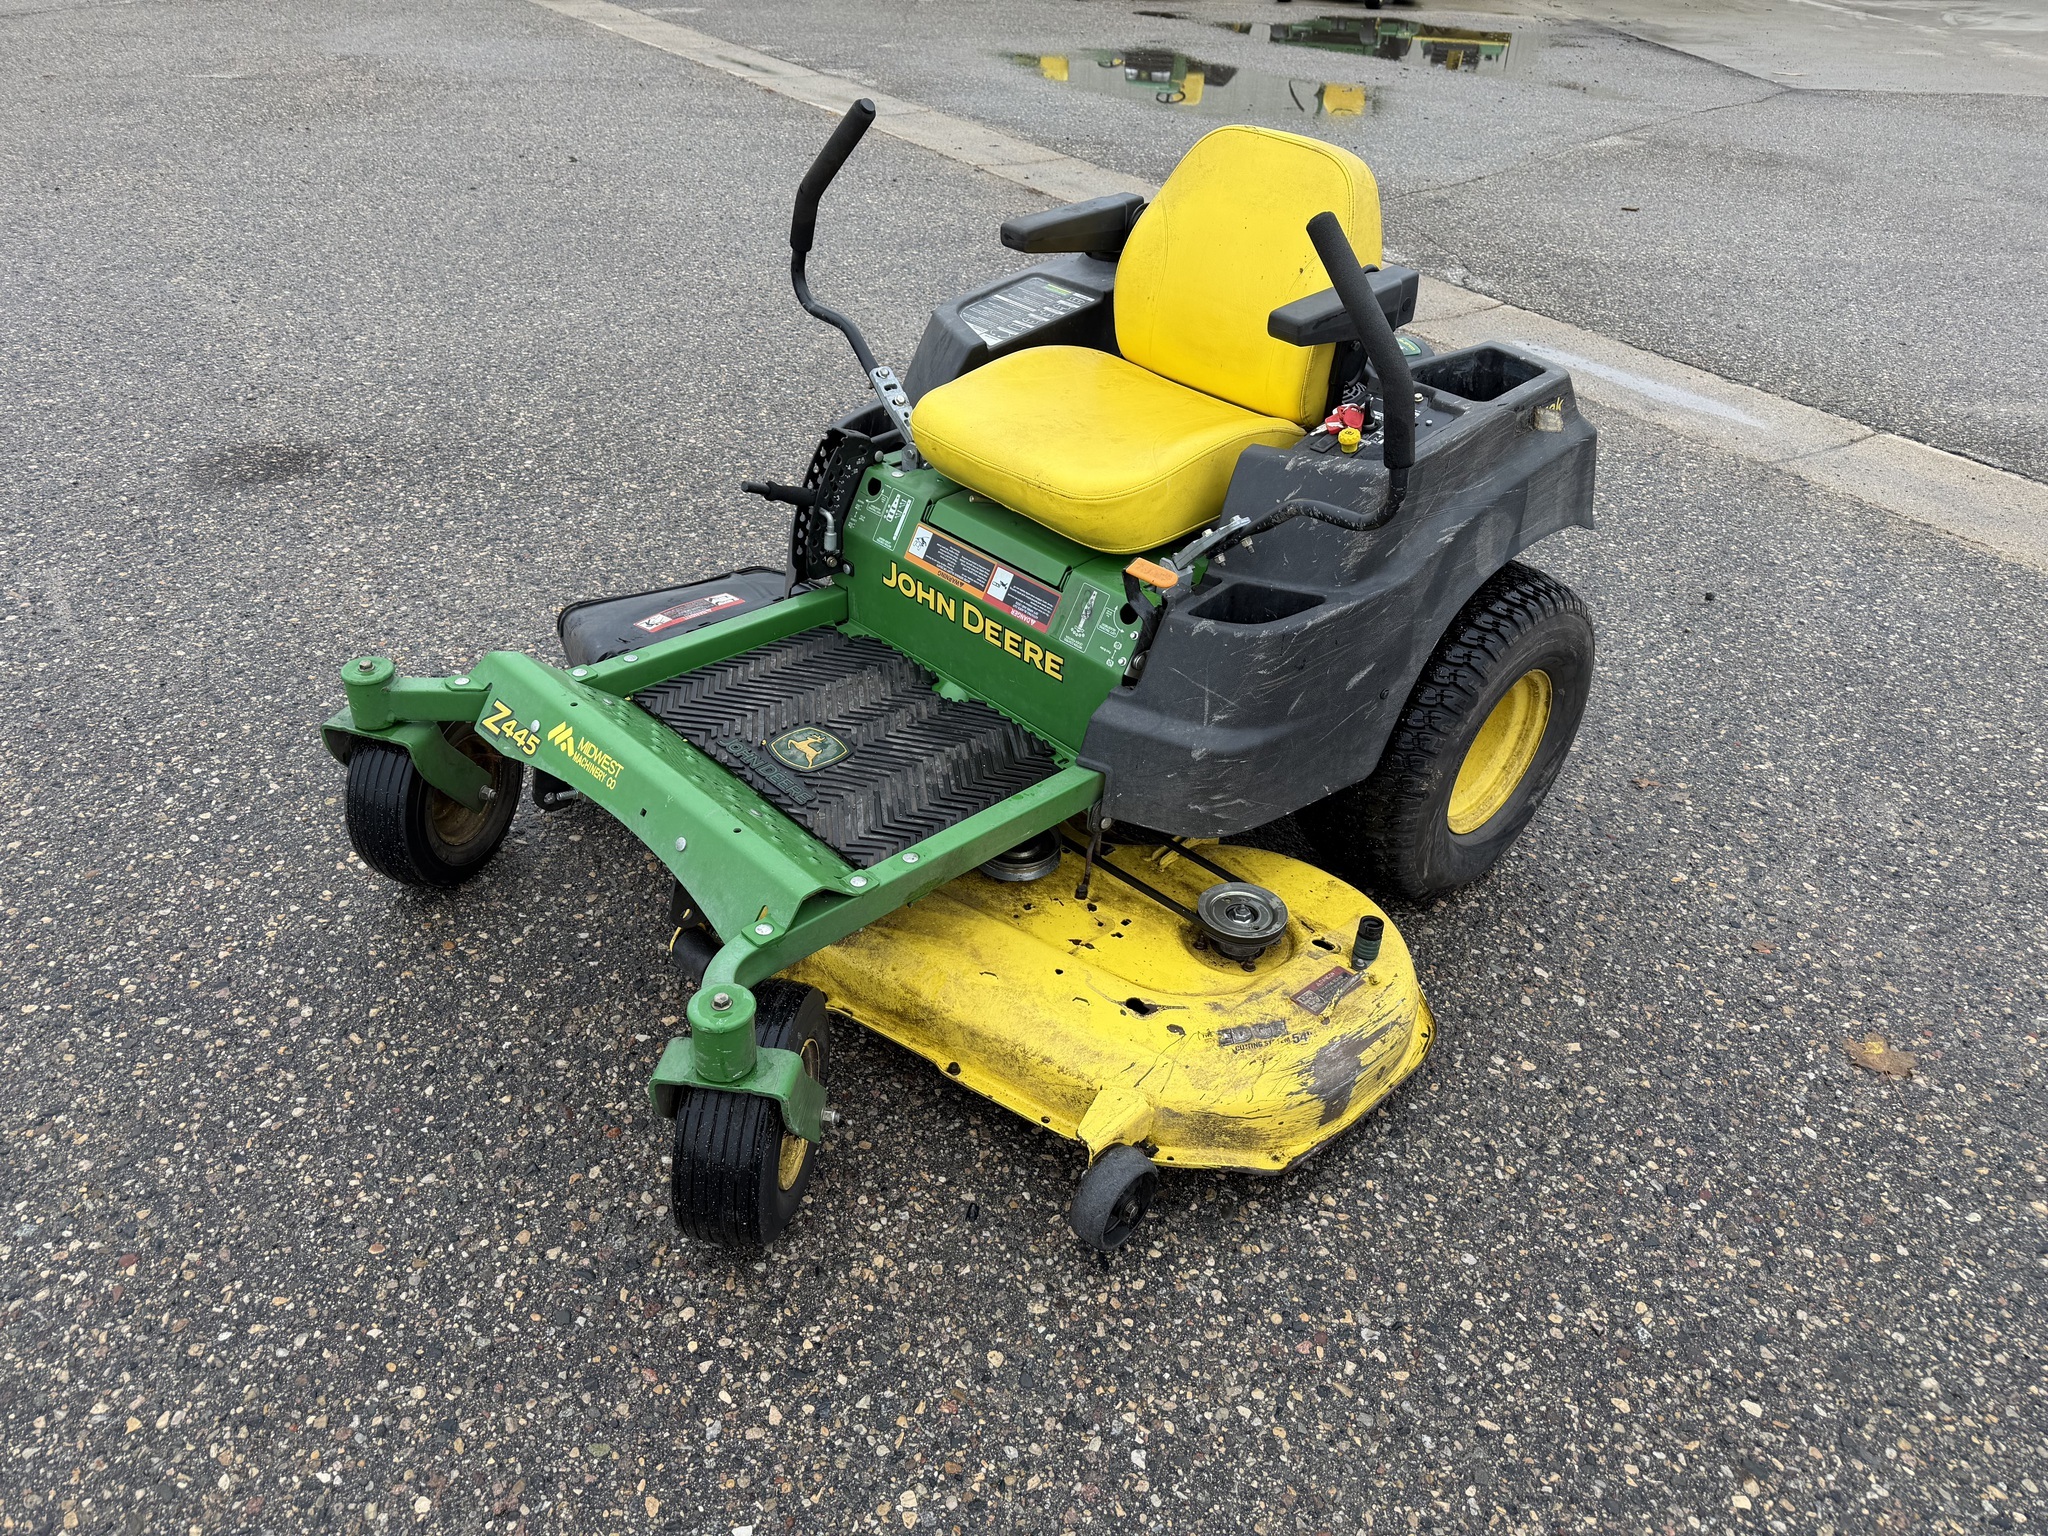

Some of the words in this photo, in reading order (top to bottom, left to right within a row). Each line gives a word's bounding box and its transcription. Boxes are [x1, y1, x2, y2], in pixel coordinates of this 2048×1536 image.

[882, 561, 956, 622] JOHN
[962, 600, 1064, 682] DEERE
[1010, 608, 1031, 624] DANGER
[481, 700, 541, 756] Z445
[572, 752, 607, 783] MACHINERY
[606, 777, 617, 790] CO
[577, 736, 624, 778] MIDWEST
[717, 738, 764, 769] JOHN
[755, 762, 814, 804] DEERE
